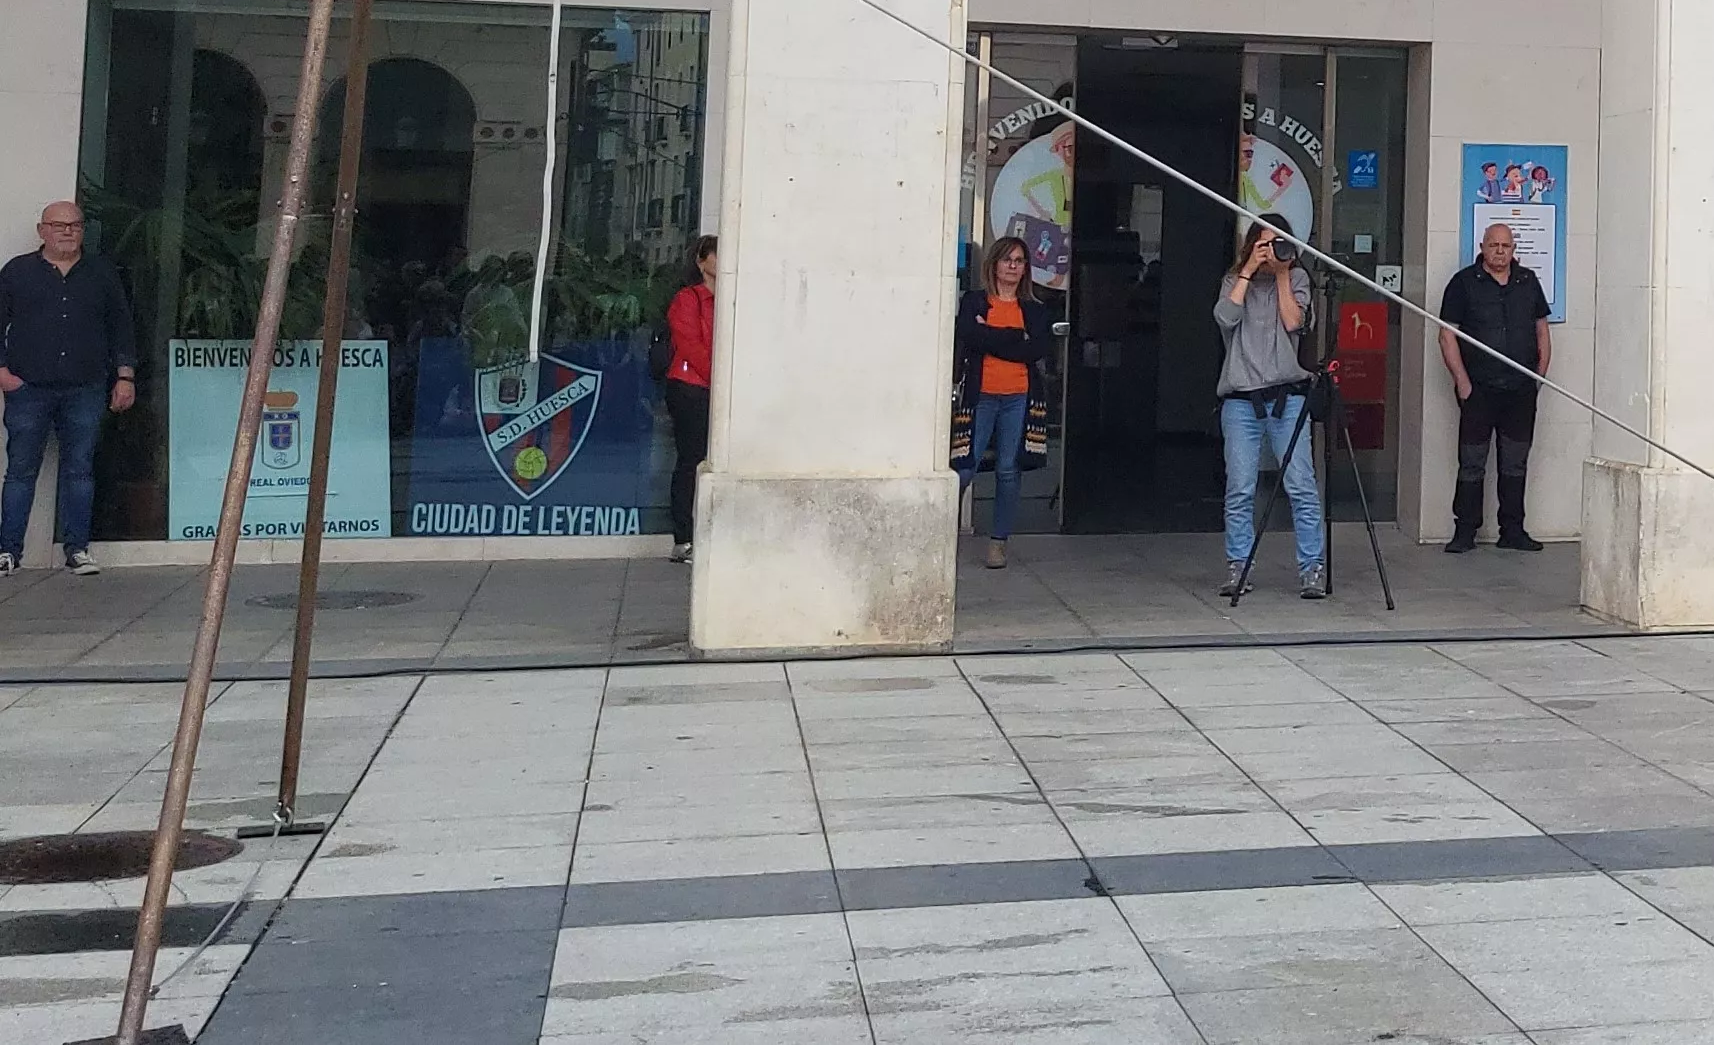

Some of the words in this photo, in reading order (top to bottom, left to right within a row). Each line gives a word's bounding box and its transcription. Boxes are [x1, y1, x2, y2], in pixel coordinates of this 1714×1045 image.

[1258, 107, 1276, 126] A
[174, 347, 295, 368] BIENVENOS
[299, 348, 311, 368] A
[315, 348, 384, 368] ESCA
[496, 414, 527, 445] S.D.
[528, 381, 590, 426] HUESCA
[250, 477, 275, 488] REAL
[182, 523, 252, 539] GRAS
[255, 522, 287, 536] POR
[289, 519, 380, 535] VITARNOS
[411, 503, 496, 534] CIUDAD
[502, 504, 531, 535] DE
[537, 505, 641, 536] LEYENDA
